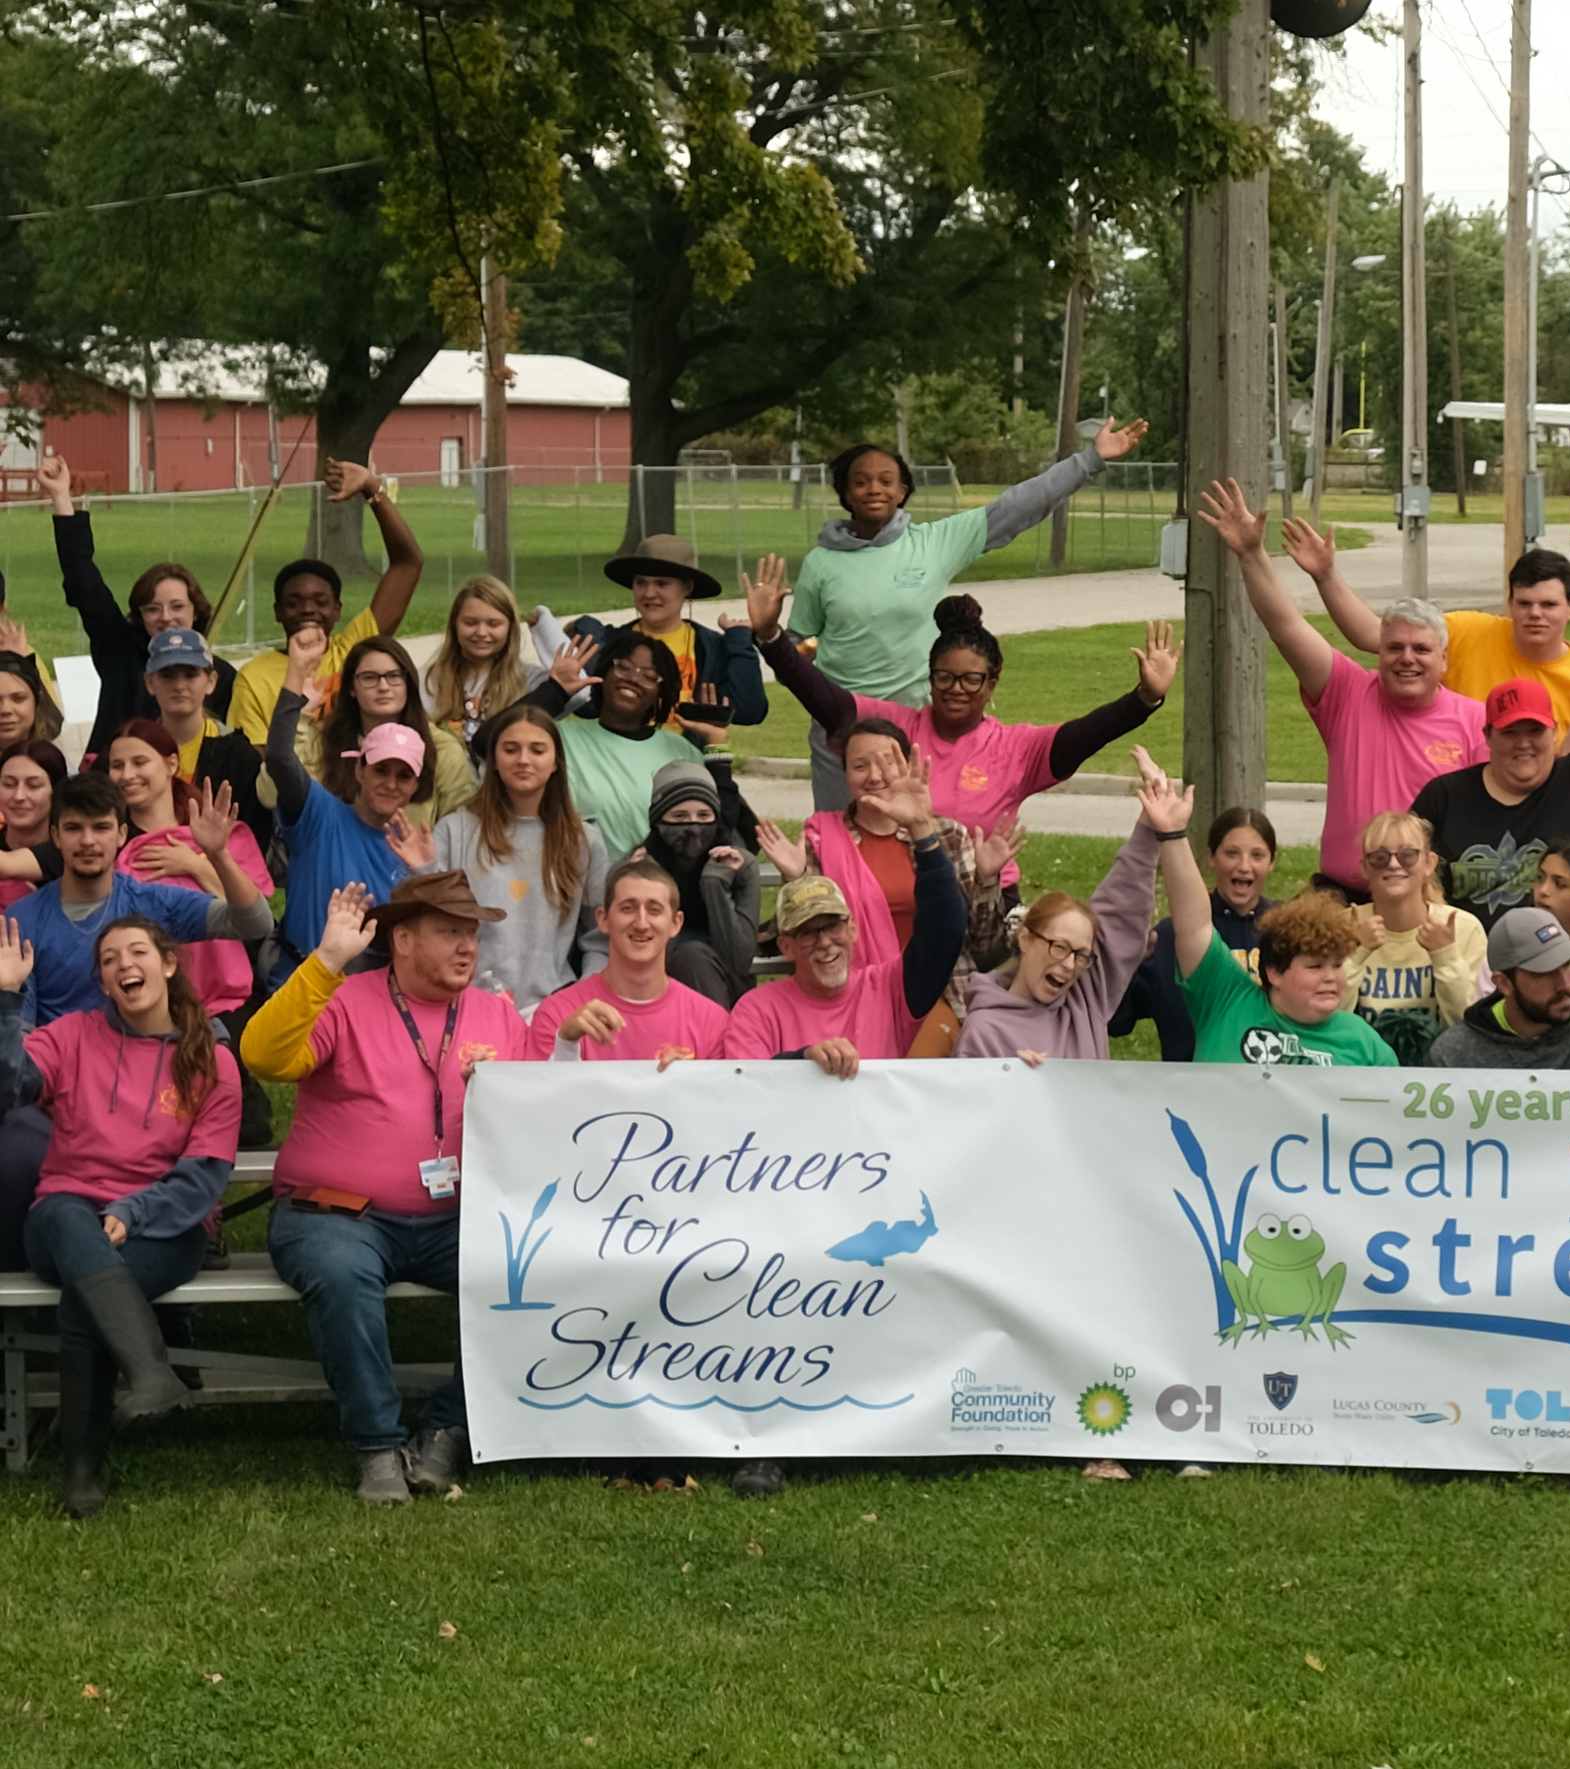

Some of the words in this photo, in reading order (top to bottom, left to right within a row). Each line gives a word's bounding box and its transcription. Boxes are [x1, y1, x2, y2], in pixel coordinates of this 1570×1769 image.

[1403, 1082, 1455, 1119] 26
[572, 1111, 891, 1203] Partners
[1268, 1113, 1510, 1200] clean
[599, 1194, 700, 1260] for
[660, 1238, 897, 1327] Clean
[525, 1307, 835, 1391] Streams
[1113, 1363, 1136, 1382] bp
[1268, 1380, 1293, 1398] UT
[951, 1391, 1056, 1410] Community
[1333, 1399, 1370, 1411] LUCAS
[1374, 1400, 1427, 1412] COUNTY
[951, 1407, 1051, 1423] Foundation
[1246, 1422, 1314, 1436] TOLEDO
[1490, 1425, 1514, 1439] City
[1517, 1425, 1530, 1437] of
